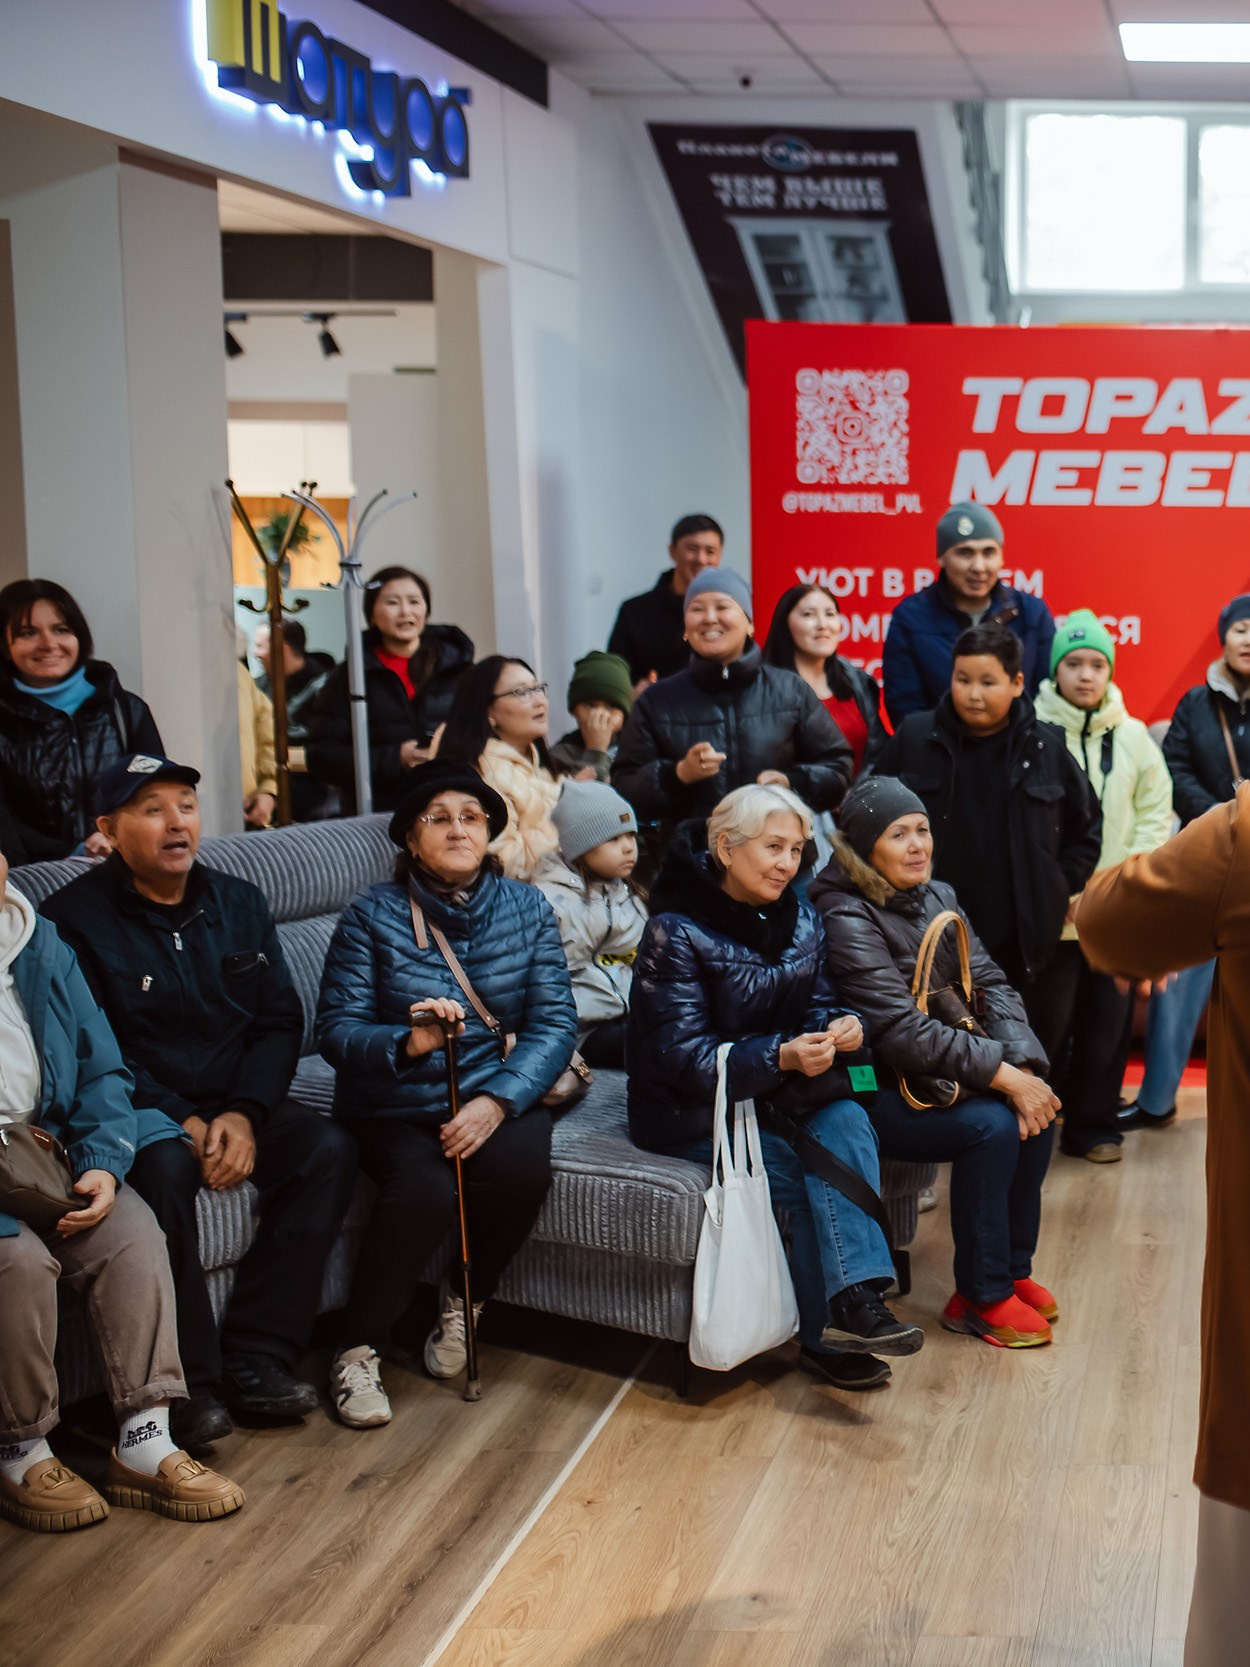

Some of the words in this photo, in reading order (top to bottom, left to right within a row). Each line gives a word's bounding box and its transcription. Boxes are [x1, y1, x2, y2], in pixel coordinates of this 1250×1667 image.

[710, 174, 776, 193] ЧЕМ
[784, 176, 884, 196] ВЫШЕ
[715, 191, 776, 208] ТЕМ
[783, 193, 888, 211] ЛУЧШЕ
[882, 567, 905, 598] В
